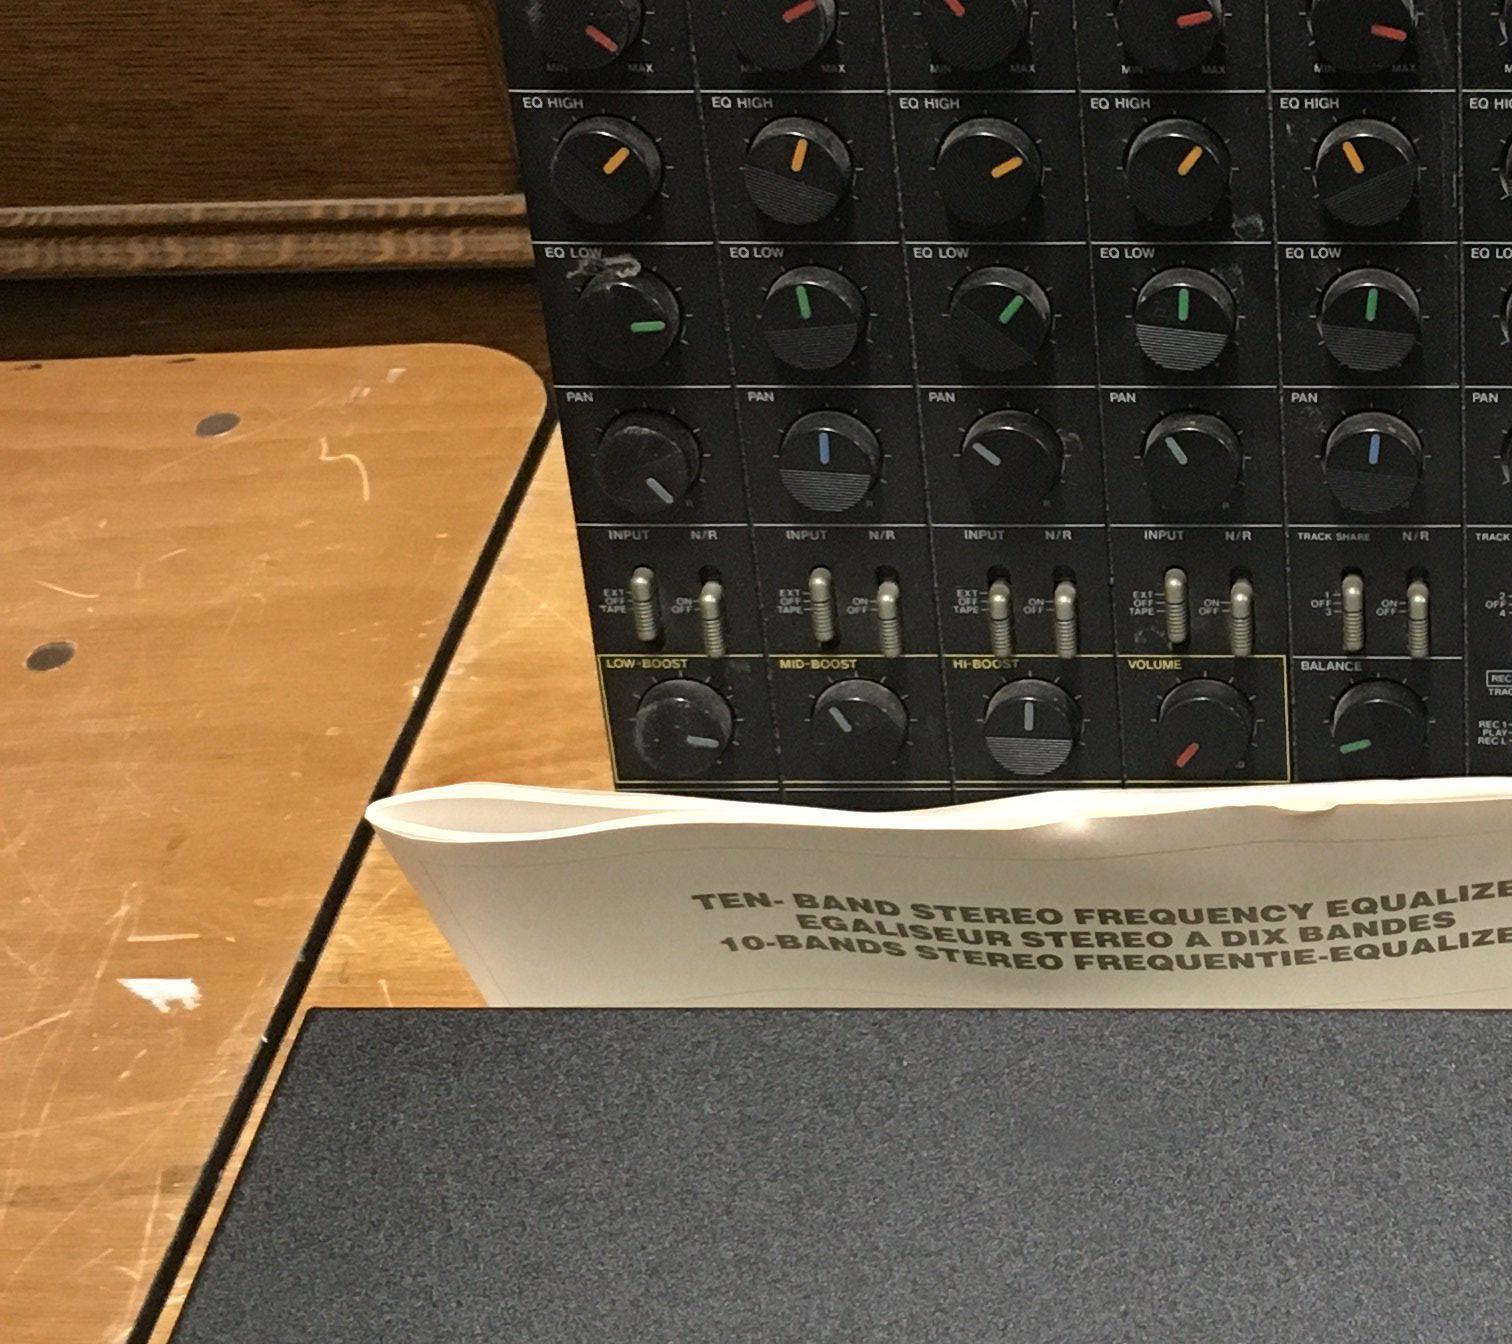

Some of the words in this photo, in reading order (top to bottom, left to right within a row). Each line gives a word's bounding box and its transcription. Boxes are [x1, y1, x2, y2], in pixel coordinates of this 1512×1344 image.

[523, 97, 543, 108] EQ
[546, 97, 583, 109] HIGH
[545, 247, 565, 258] EQ
[570, 247, 601, 259] LOW
[566, 392, 593, 402] PAN
[608, 530, 648, 540] INPUT
[691, 530, 717, 539] N/R
[1298, 532, 1332, 540] TRACK
[1336, 531, 1371, 543] SHARE
[606, 658, 687, 668] LOW-BOOST
[779, 659, 856, 669] MID-BOOST
[953, 659, 1019, 669] HI-BOOST
[1128, 659, 1181, 670] VOLUME
[1301, 659, 1361, 671] BALANCE
[691, 892, 784, 910] TEN-
[791, 893, 901, 923] BAND
[910, 904, 1063, 930] STEREO
[1074, 903, 1313, 925] FREQUENCY
[796, 911, 1013, 946] EGALISEUR
[1020, 927, 1173, 949] STEREO
[1218, 924, 1289, 946] DIX
[1298, 910, 1456, 943] BANDES
[720, 935, 911, 964] 10-BANDS
[913, 946, 1062, 971] STEREO
